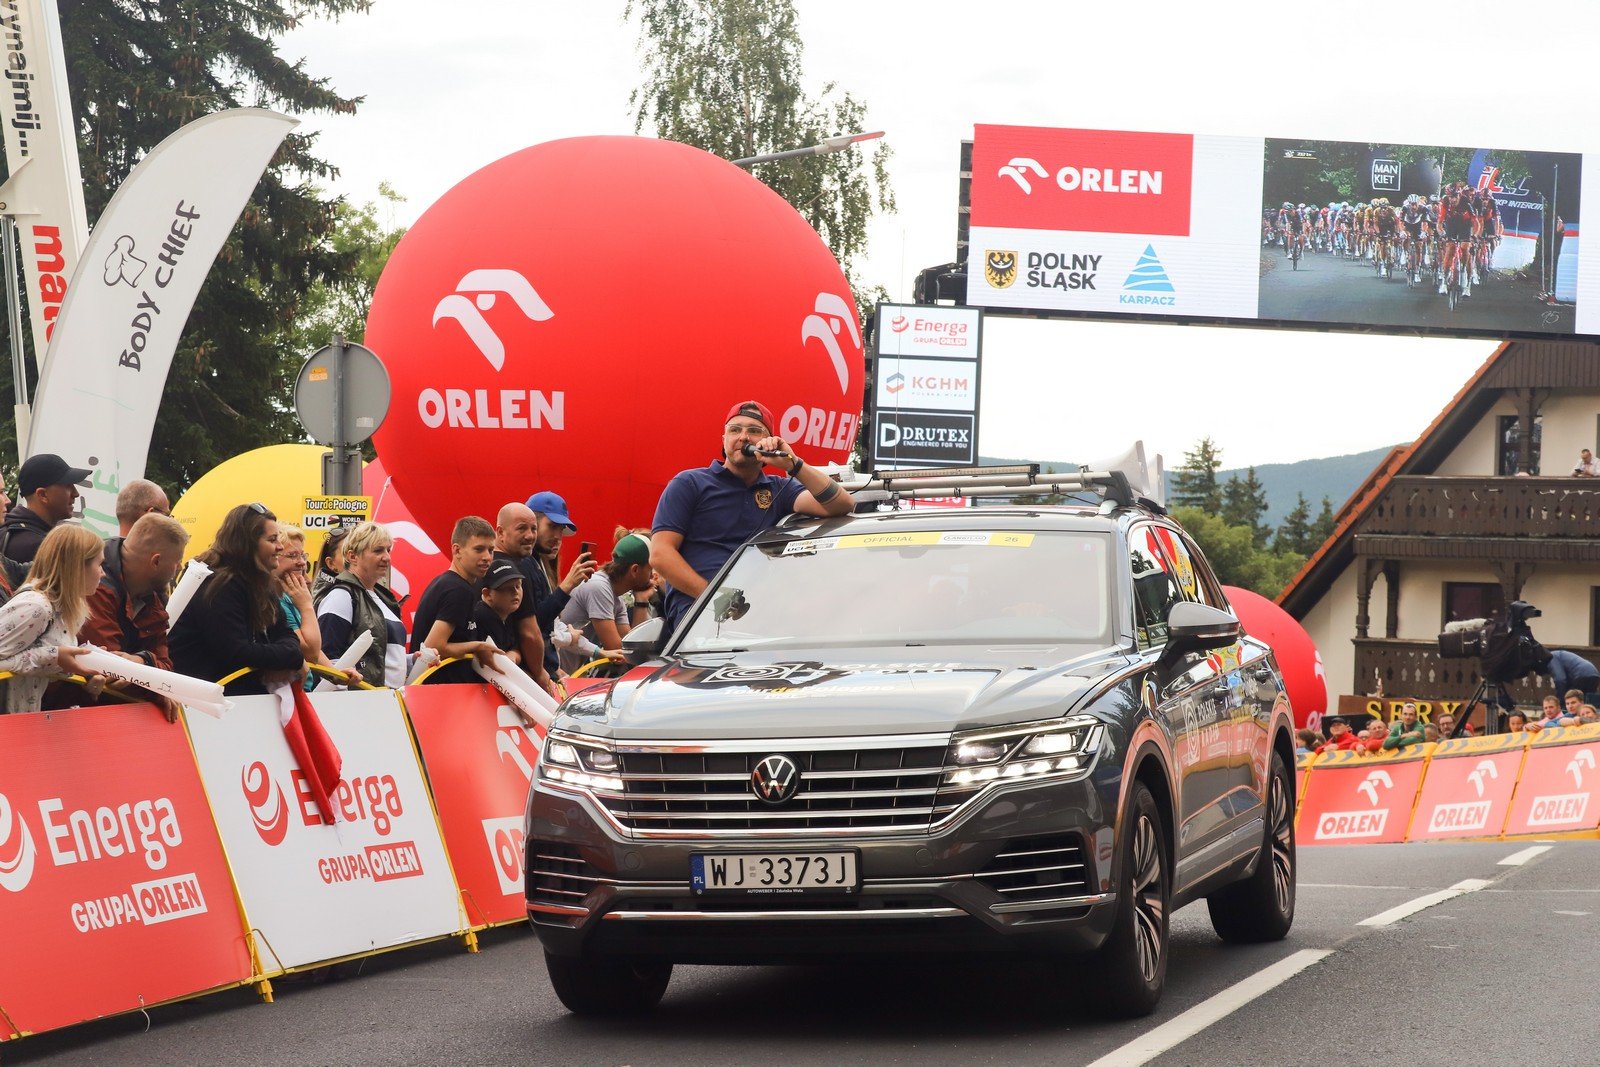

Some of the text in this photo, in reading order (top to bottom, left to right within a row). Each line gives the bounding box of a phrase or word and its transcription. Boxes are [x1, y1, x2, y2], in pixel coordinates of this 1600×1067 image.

[1056, 166, 1162, 195] ORLEN
[1374, 163, 1398, 175] MAN
[1374, 174, 1395, 184] KIET
[1027, 251, 1103, 271] DOLNY
[118, 199, 201, 373] BODY CHIEF
[1026, 265, 1097, 291] ŚLĄSK
[1119, 294, 1175, 306] KARPACZ
[914, 318, 968, 336] Energa
[912, 376, 968, 391] KGHM
[418, 387, 565, 431] ORLEN
[780, 404, 860, 452] ORLEN
[902, 426, 969, 442] DRUTEX
[903, 440, 939, 448] ENGINEERED
[941, 441, 953, 449] FOR
[305, 516, 326, 527] UCI
[290, 769, 403, 836] Eerga
[1533, 797, 1585, 820] ORLEN
[1322, 813, 1383, 836] ORLEN
[1434, 805, 1487, 828] ORLEN
[38, 797, 183, 871] Energa
[318, 846, 420, 885] GRUPA ORLEN
[710, 856, 846, 886] WJ 3373J
[693, 876, 704, 884] PL
[71, 879, 202, 933] GRUPA ORLEN
